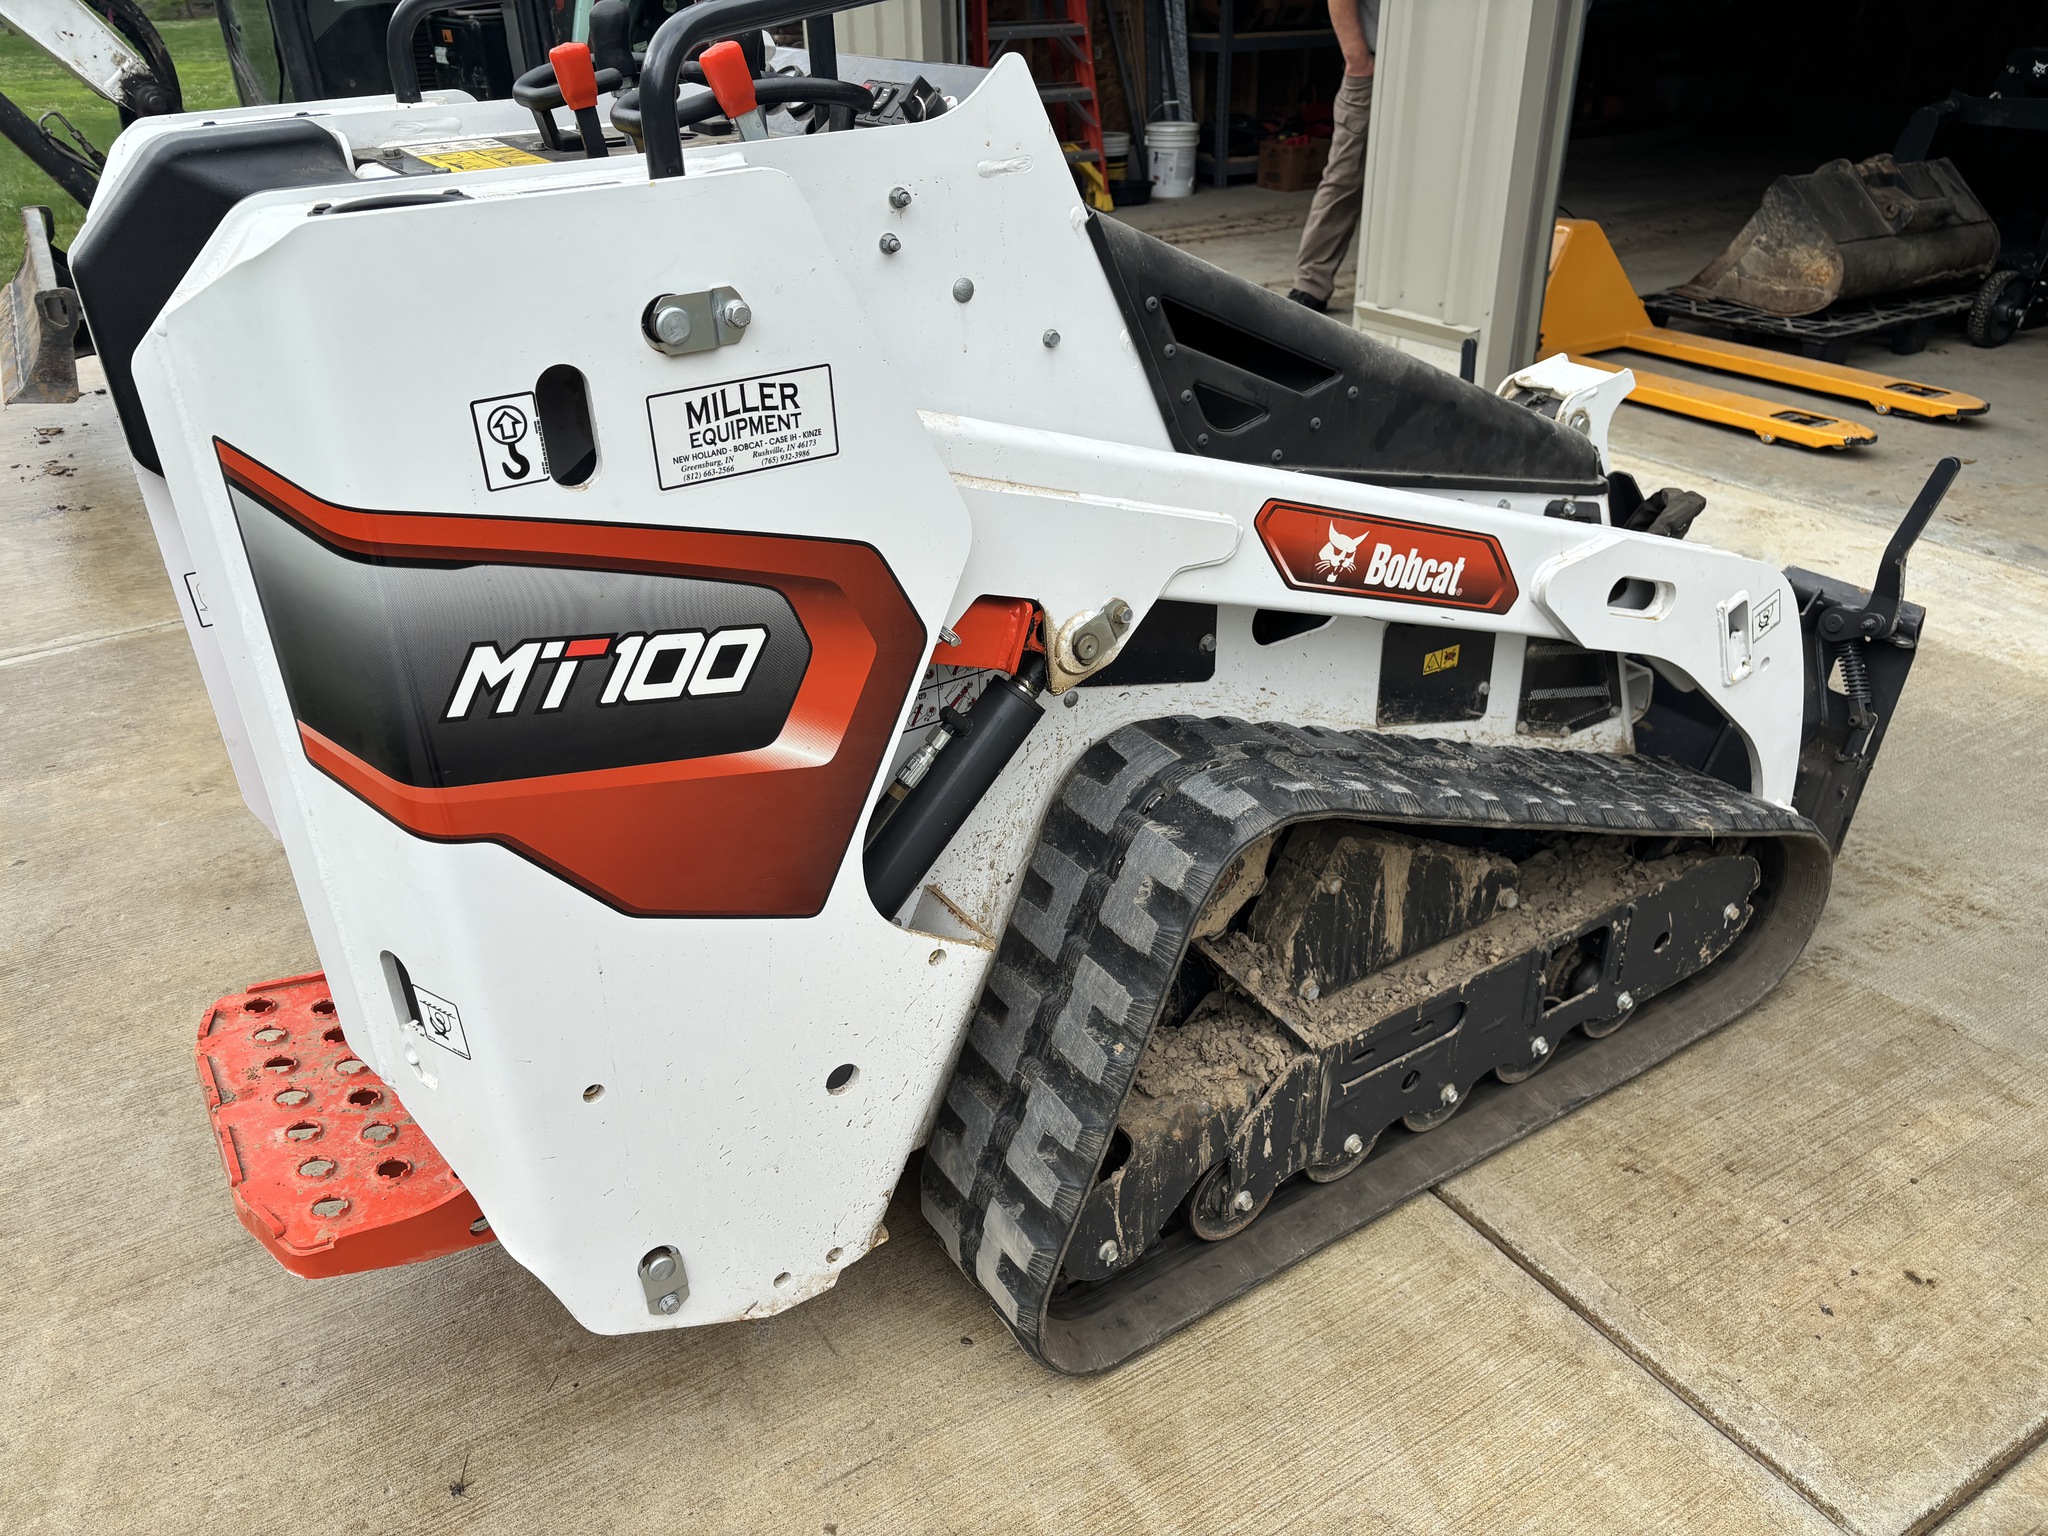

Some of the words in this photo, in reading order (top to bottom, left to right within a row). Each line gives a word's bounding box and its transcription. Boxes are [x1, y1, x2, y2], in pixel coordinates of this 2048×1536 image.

[685, 383, 801, 429] MILLER
[689, 412, 802, 449] EQUIPMENT
[672, 455, 690, 464] NEW
[692, 447, 728, 461] HOLLAND
[733, 440, 763, 453] BOBCAT
[769, 435, 788, 445] CASE
[789, 433, 797, 441] IH
[802, 428, 822, 438] KINZE
[752, 446, 785, 458] Rushville,
[786, 443, 796, 451] IN
[797, 439, 817, 449] 46173
[761, 456, 779, 466] (765)
[780, 449, 810, 462] 932-3986
[681, 460, 724, 472] Greensburg,
[725, 455, 735, 463] IN
[683, 472, 702, 482] (812)
[703, 465, 735, 478] 663-2566
[446, 627, 767, 718] MT100
